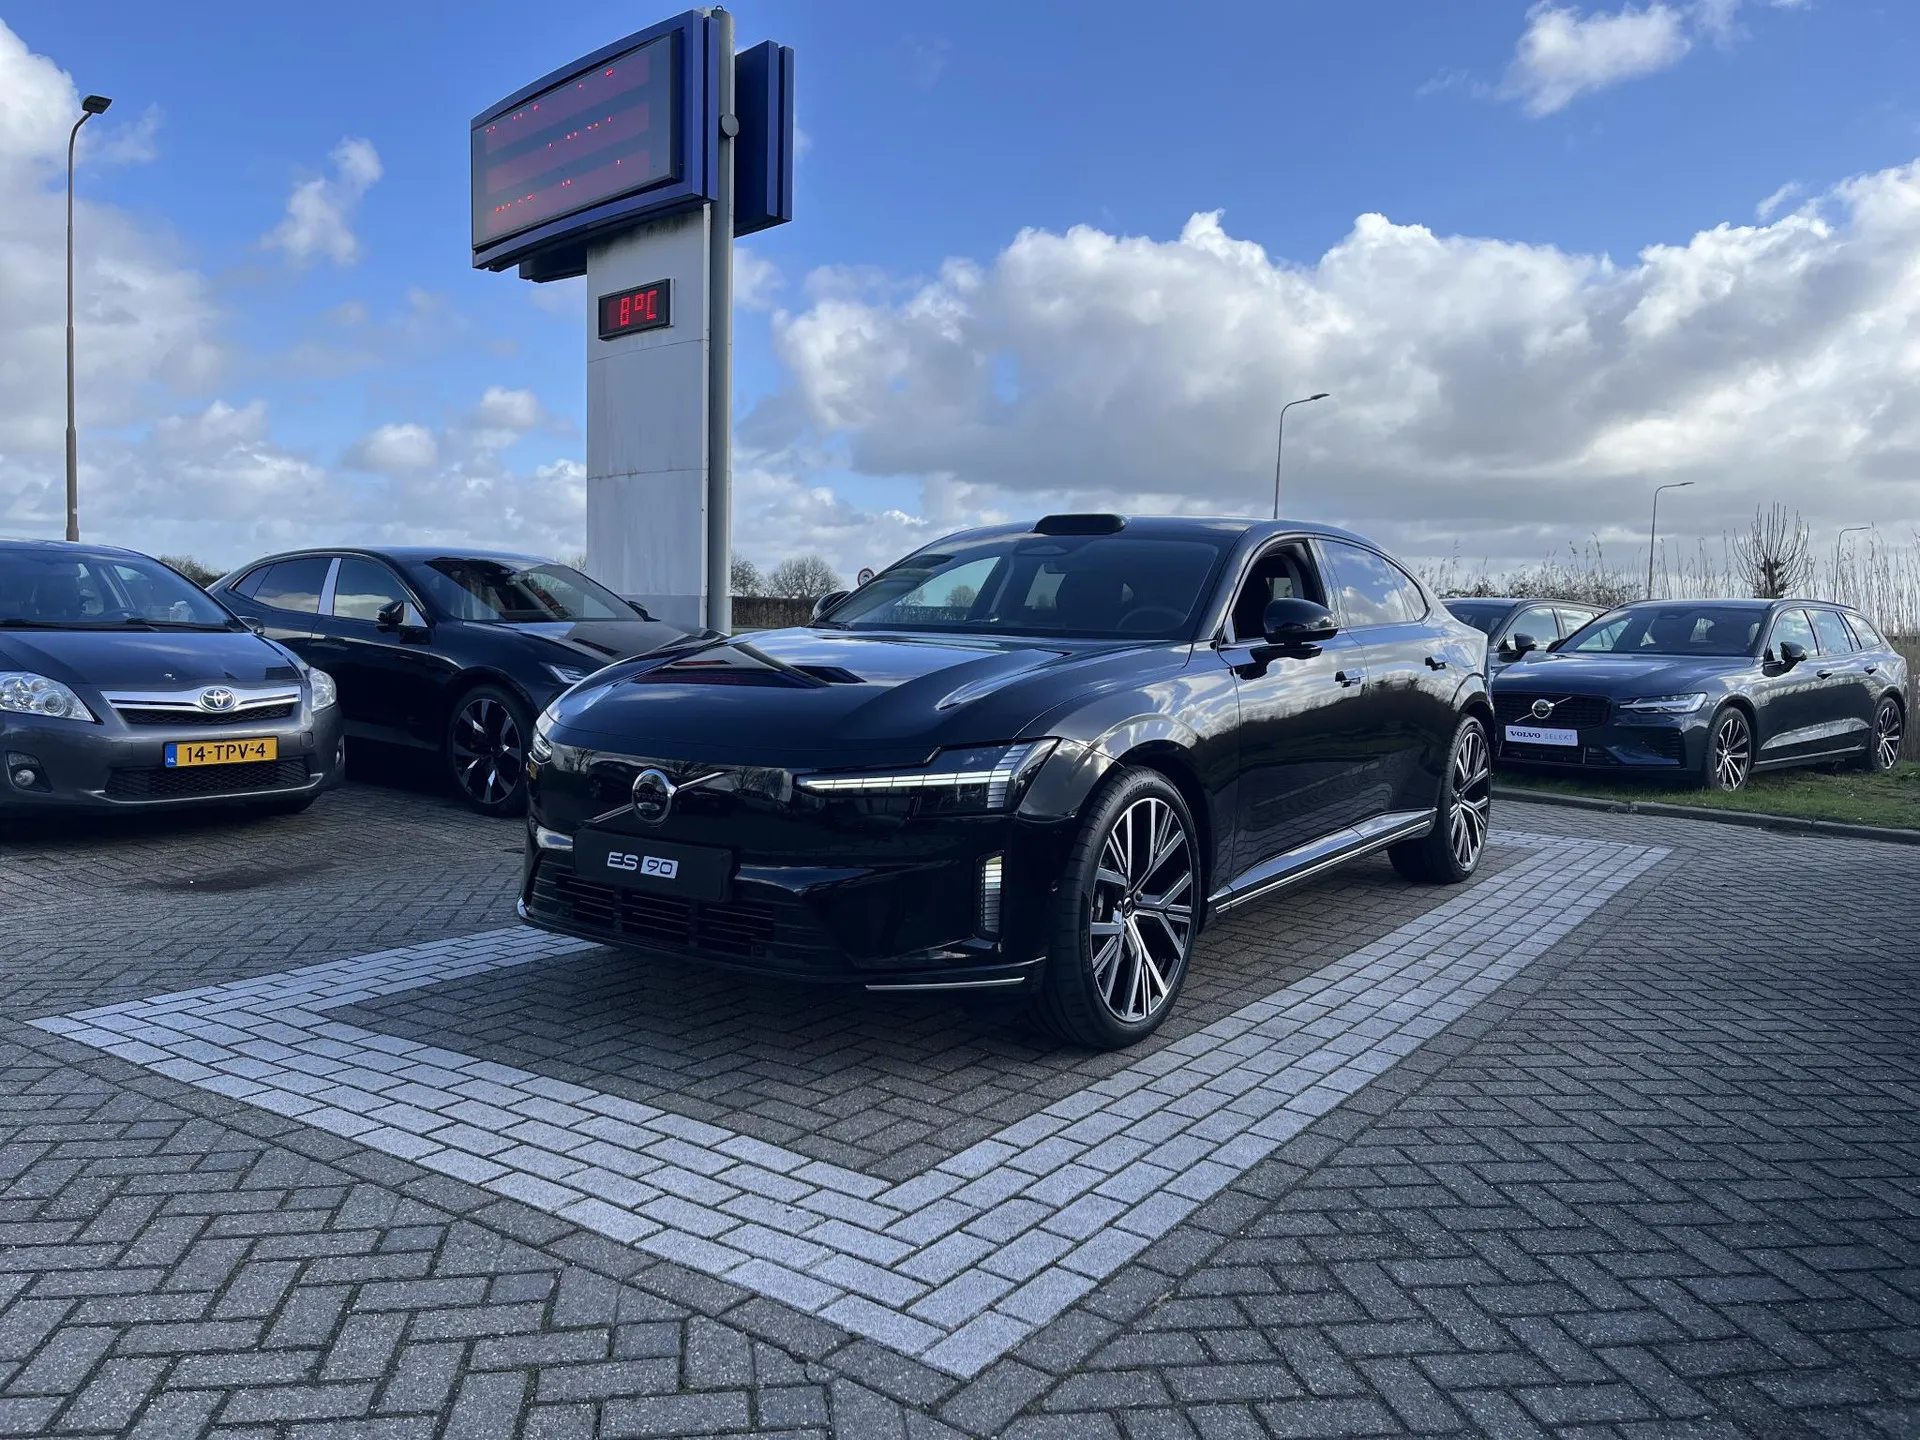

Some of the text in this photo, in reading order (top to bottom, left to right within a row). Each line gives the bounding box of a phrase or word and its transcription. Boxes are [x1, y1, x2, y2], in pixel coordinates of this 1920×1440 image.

[1509, 730, 1573, 741] VOLVO SELEKT
[187, 742, 266, 763] 14-TPV-4
[607, 851, 674, 875] ES 90
